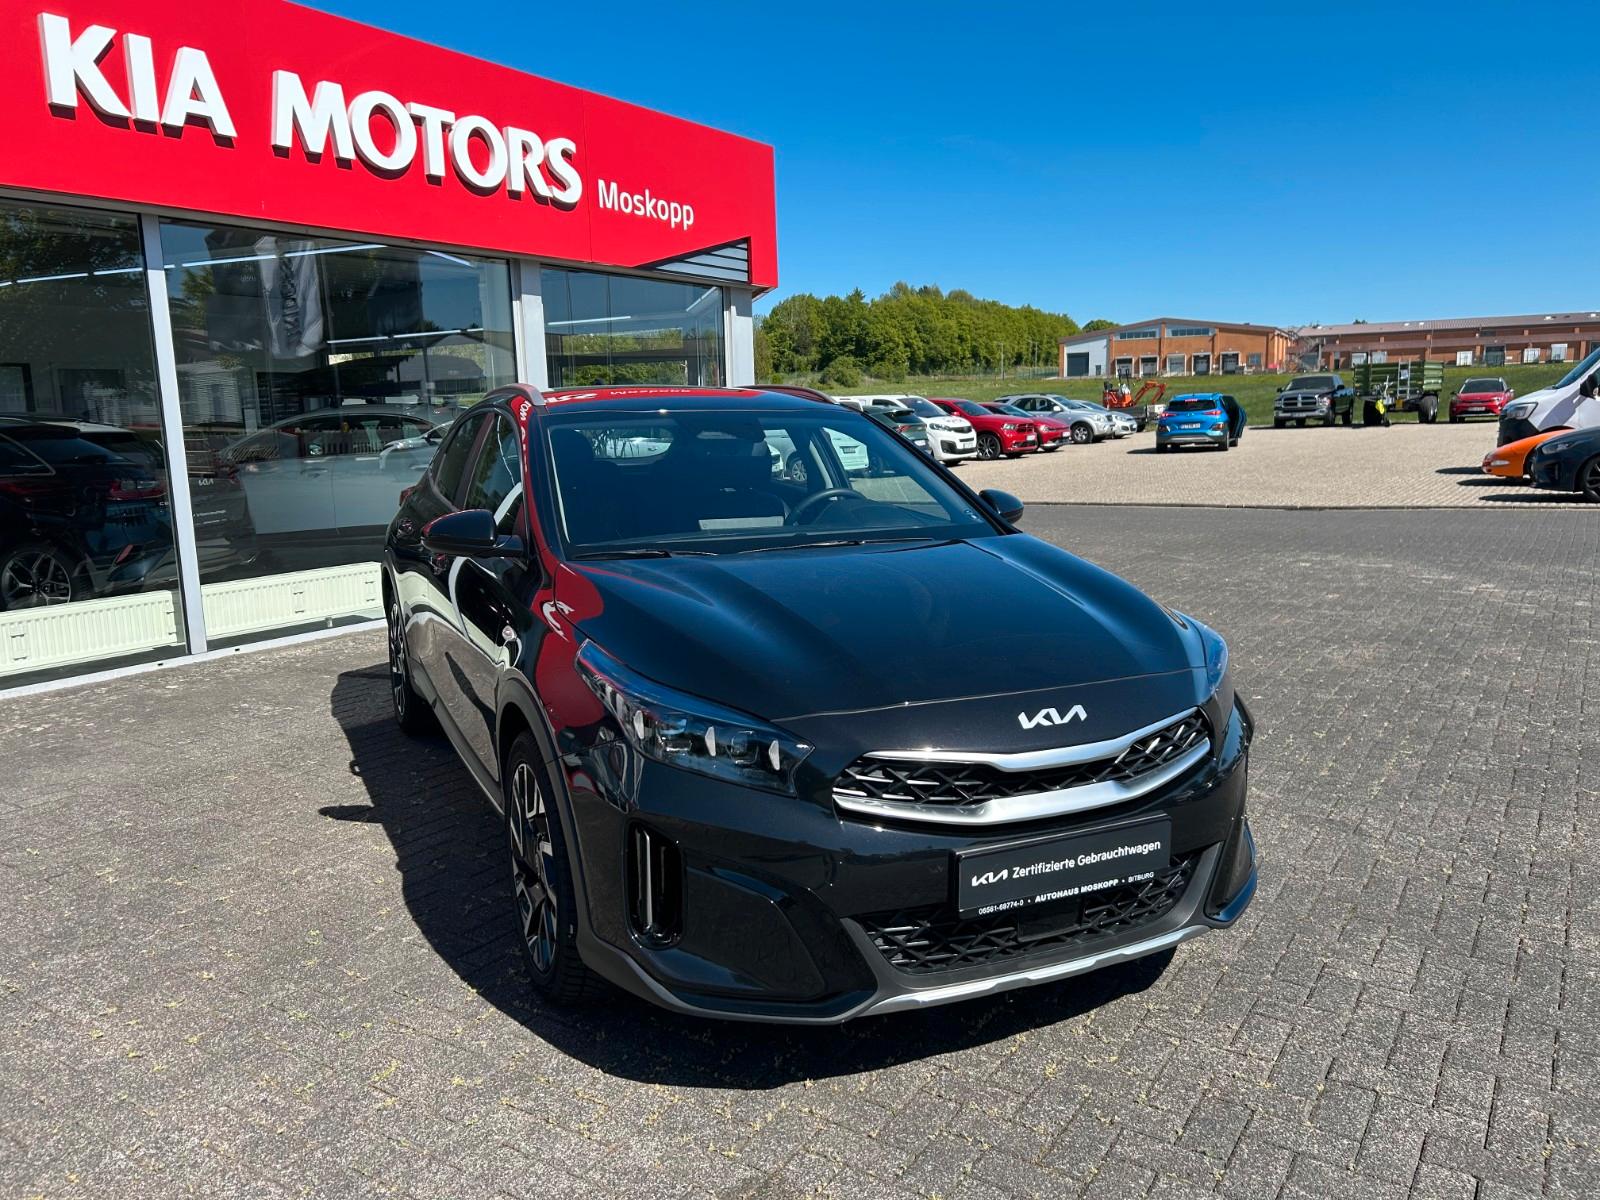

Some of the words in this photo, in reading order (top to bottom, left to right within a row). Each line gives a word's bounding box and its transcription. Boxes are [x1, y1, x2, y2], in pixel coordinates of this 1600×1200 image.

[37, 11, 238, 140] KIA
[271, 69, 583, 205] MOTORS
[597, 178, 695, 231] Moskopp
[1017, 704, 1088, 730] KIA
[971, 868, 1009, 887] KIA
[1012, 858, 1075, 879] Zertifizierte
[1078, 840, 1161, 867] Gebrauchtwagen
[1035, 886, 1079, 903] AUTOHAUS
[1080, 878, 1119, 893] MOSKOPP
[1127, 871, 1155, 883] BITBURG
